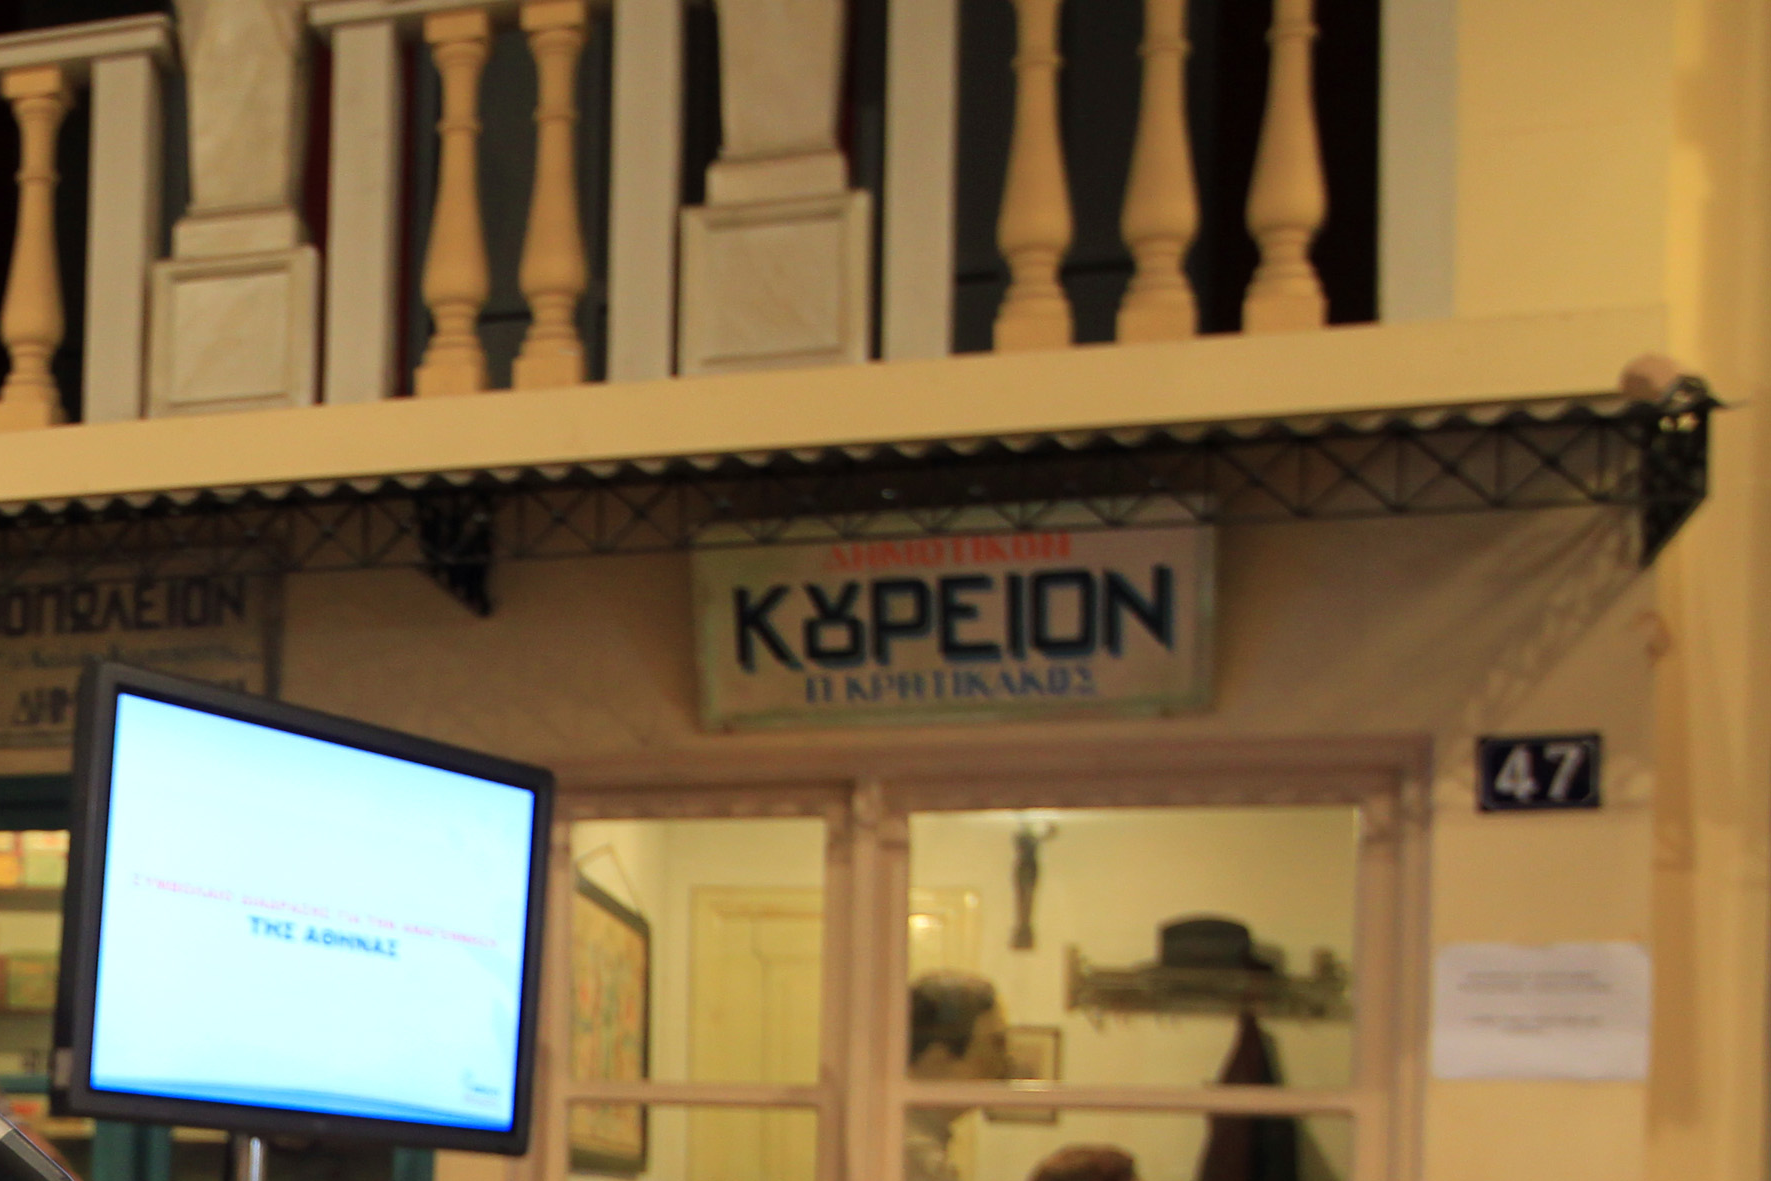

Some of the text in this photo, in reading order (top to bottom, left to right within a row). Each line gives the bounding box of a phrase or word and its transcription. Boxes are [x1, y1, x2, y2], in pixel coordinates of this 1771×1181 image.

[1493, 741, 1587, 801] 47
[248, 914, 296, 943] ΤΗΣ
[304, 924, 399, 960] ΑΘΗΝΑΣ
